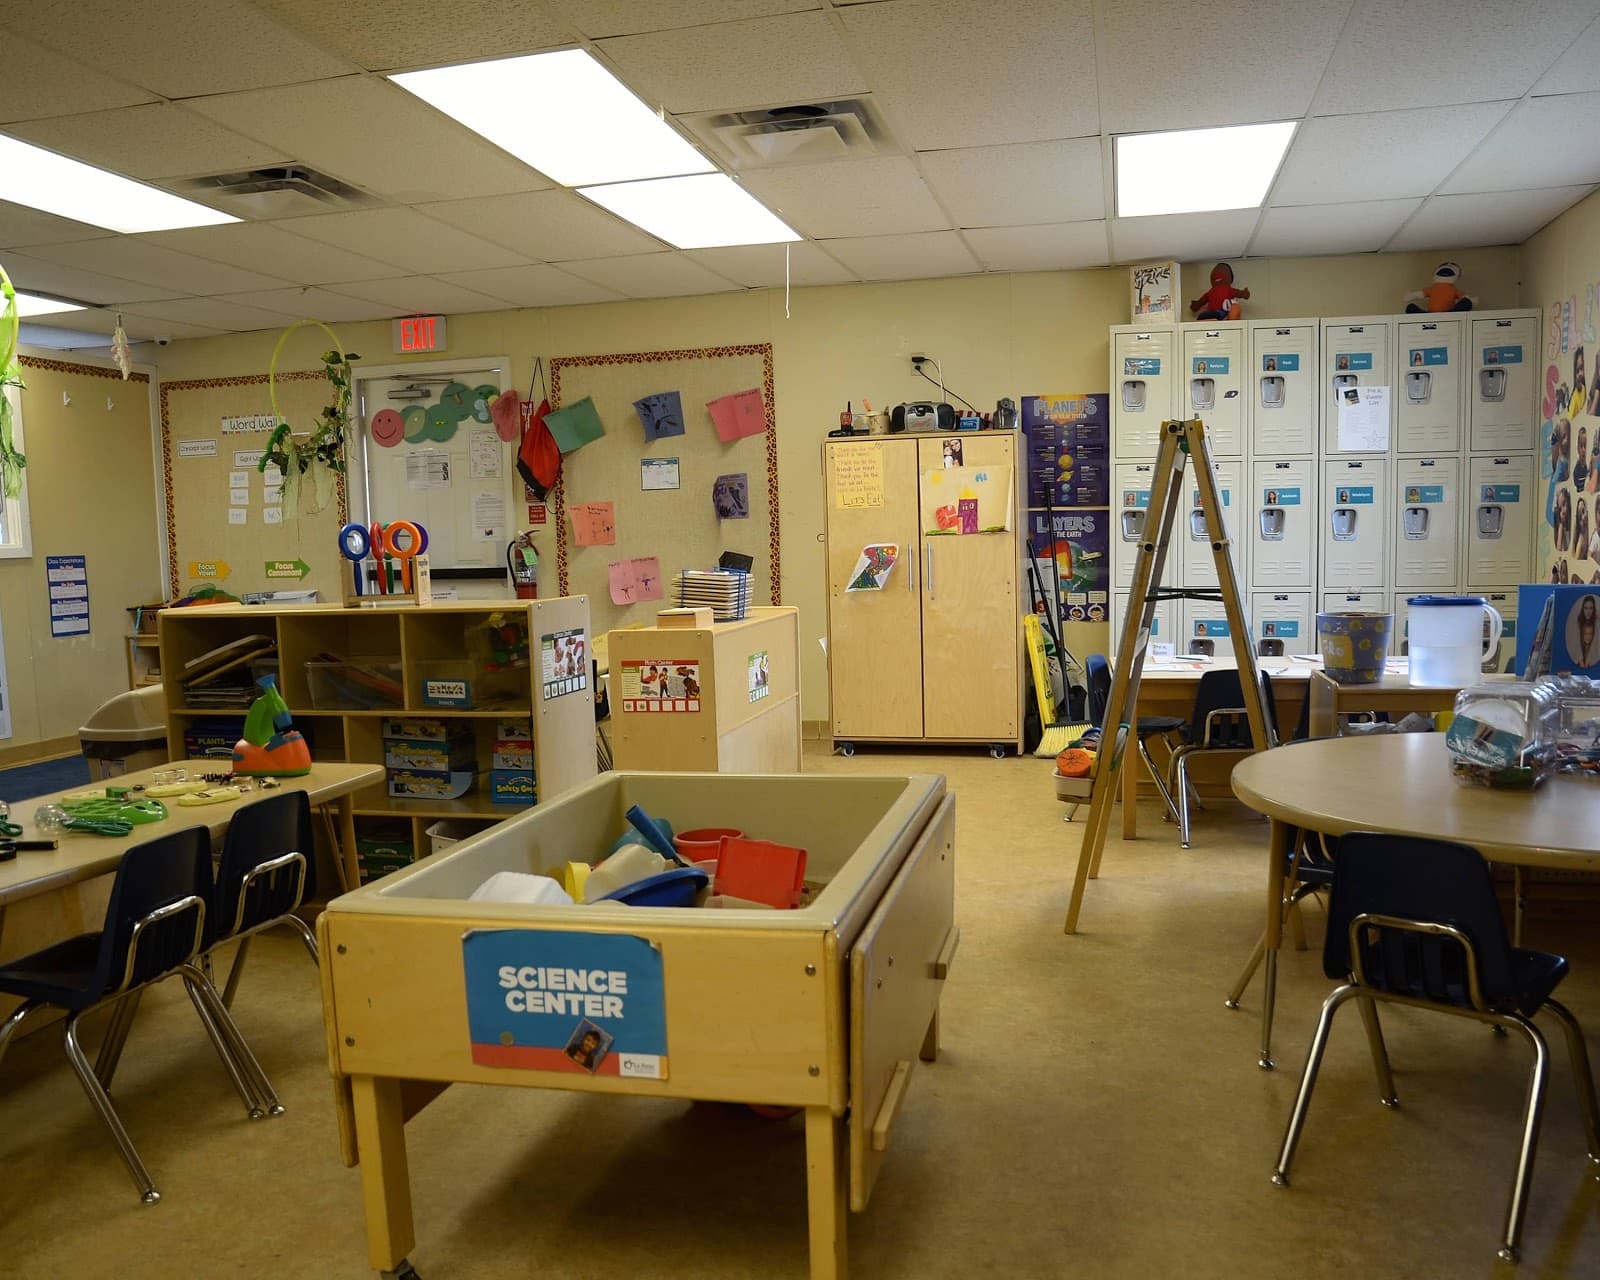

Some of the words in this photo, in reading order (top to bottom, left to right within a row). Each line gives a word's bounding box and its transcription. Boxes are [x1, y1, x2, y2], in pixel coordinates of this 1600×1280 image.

[400, 318, 436, 351] EXIT
[1034, 397, 1097, 417] PLANETS
[230, 420, 256, 430] Word
[274, 562, 294, 570] Focus
[198, 569, 217, 577] Vowel
[267, 569, 302, 577] Consonant
[496, 784, 519, 793] Safety
[498, 965, 627, 994] SCIENCE
[505, 989, 624, 1018] CENTER
